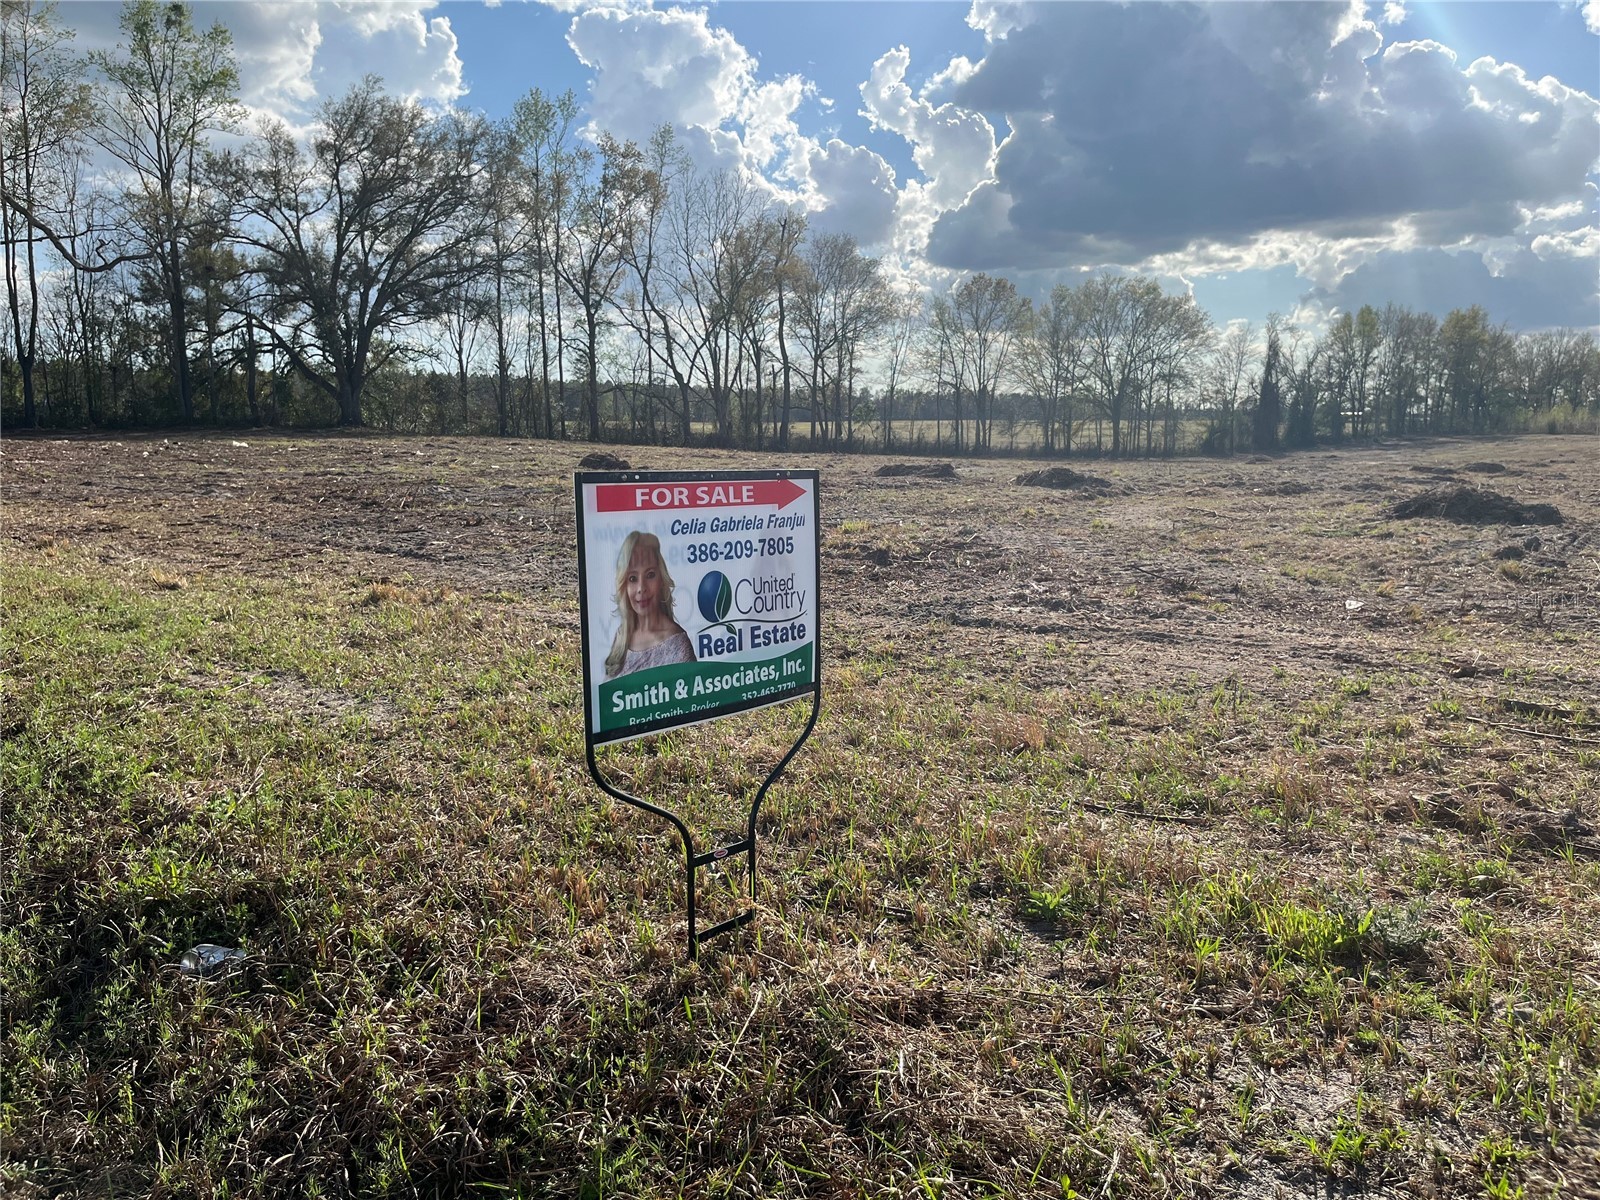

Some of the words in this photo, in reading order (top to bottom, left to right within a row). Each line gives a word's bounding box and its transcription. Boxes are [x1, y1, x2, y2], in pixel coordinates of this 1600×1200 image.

[635, 488, 690, 508] FOR
[696, 485, 755, 505] SALE
[670, 519, 706, 536] Celia
[710, 515, 764, 533] Gabriela
[686, 536, 794, 564] 386-209-7805
[735, 579, 806, 614] Country
[752, 573, 794, 595] United
[699, 628, 743, 659] Real
[750, 621, 807, 649] Estate
[612, 684, 670, 713] Smith
[674, 678, 689, 700] &
[692, 663, 780, 697] Associates,
[783, 656, 806, 676] Inc.
